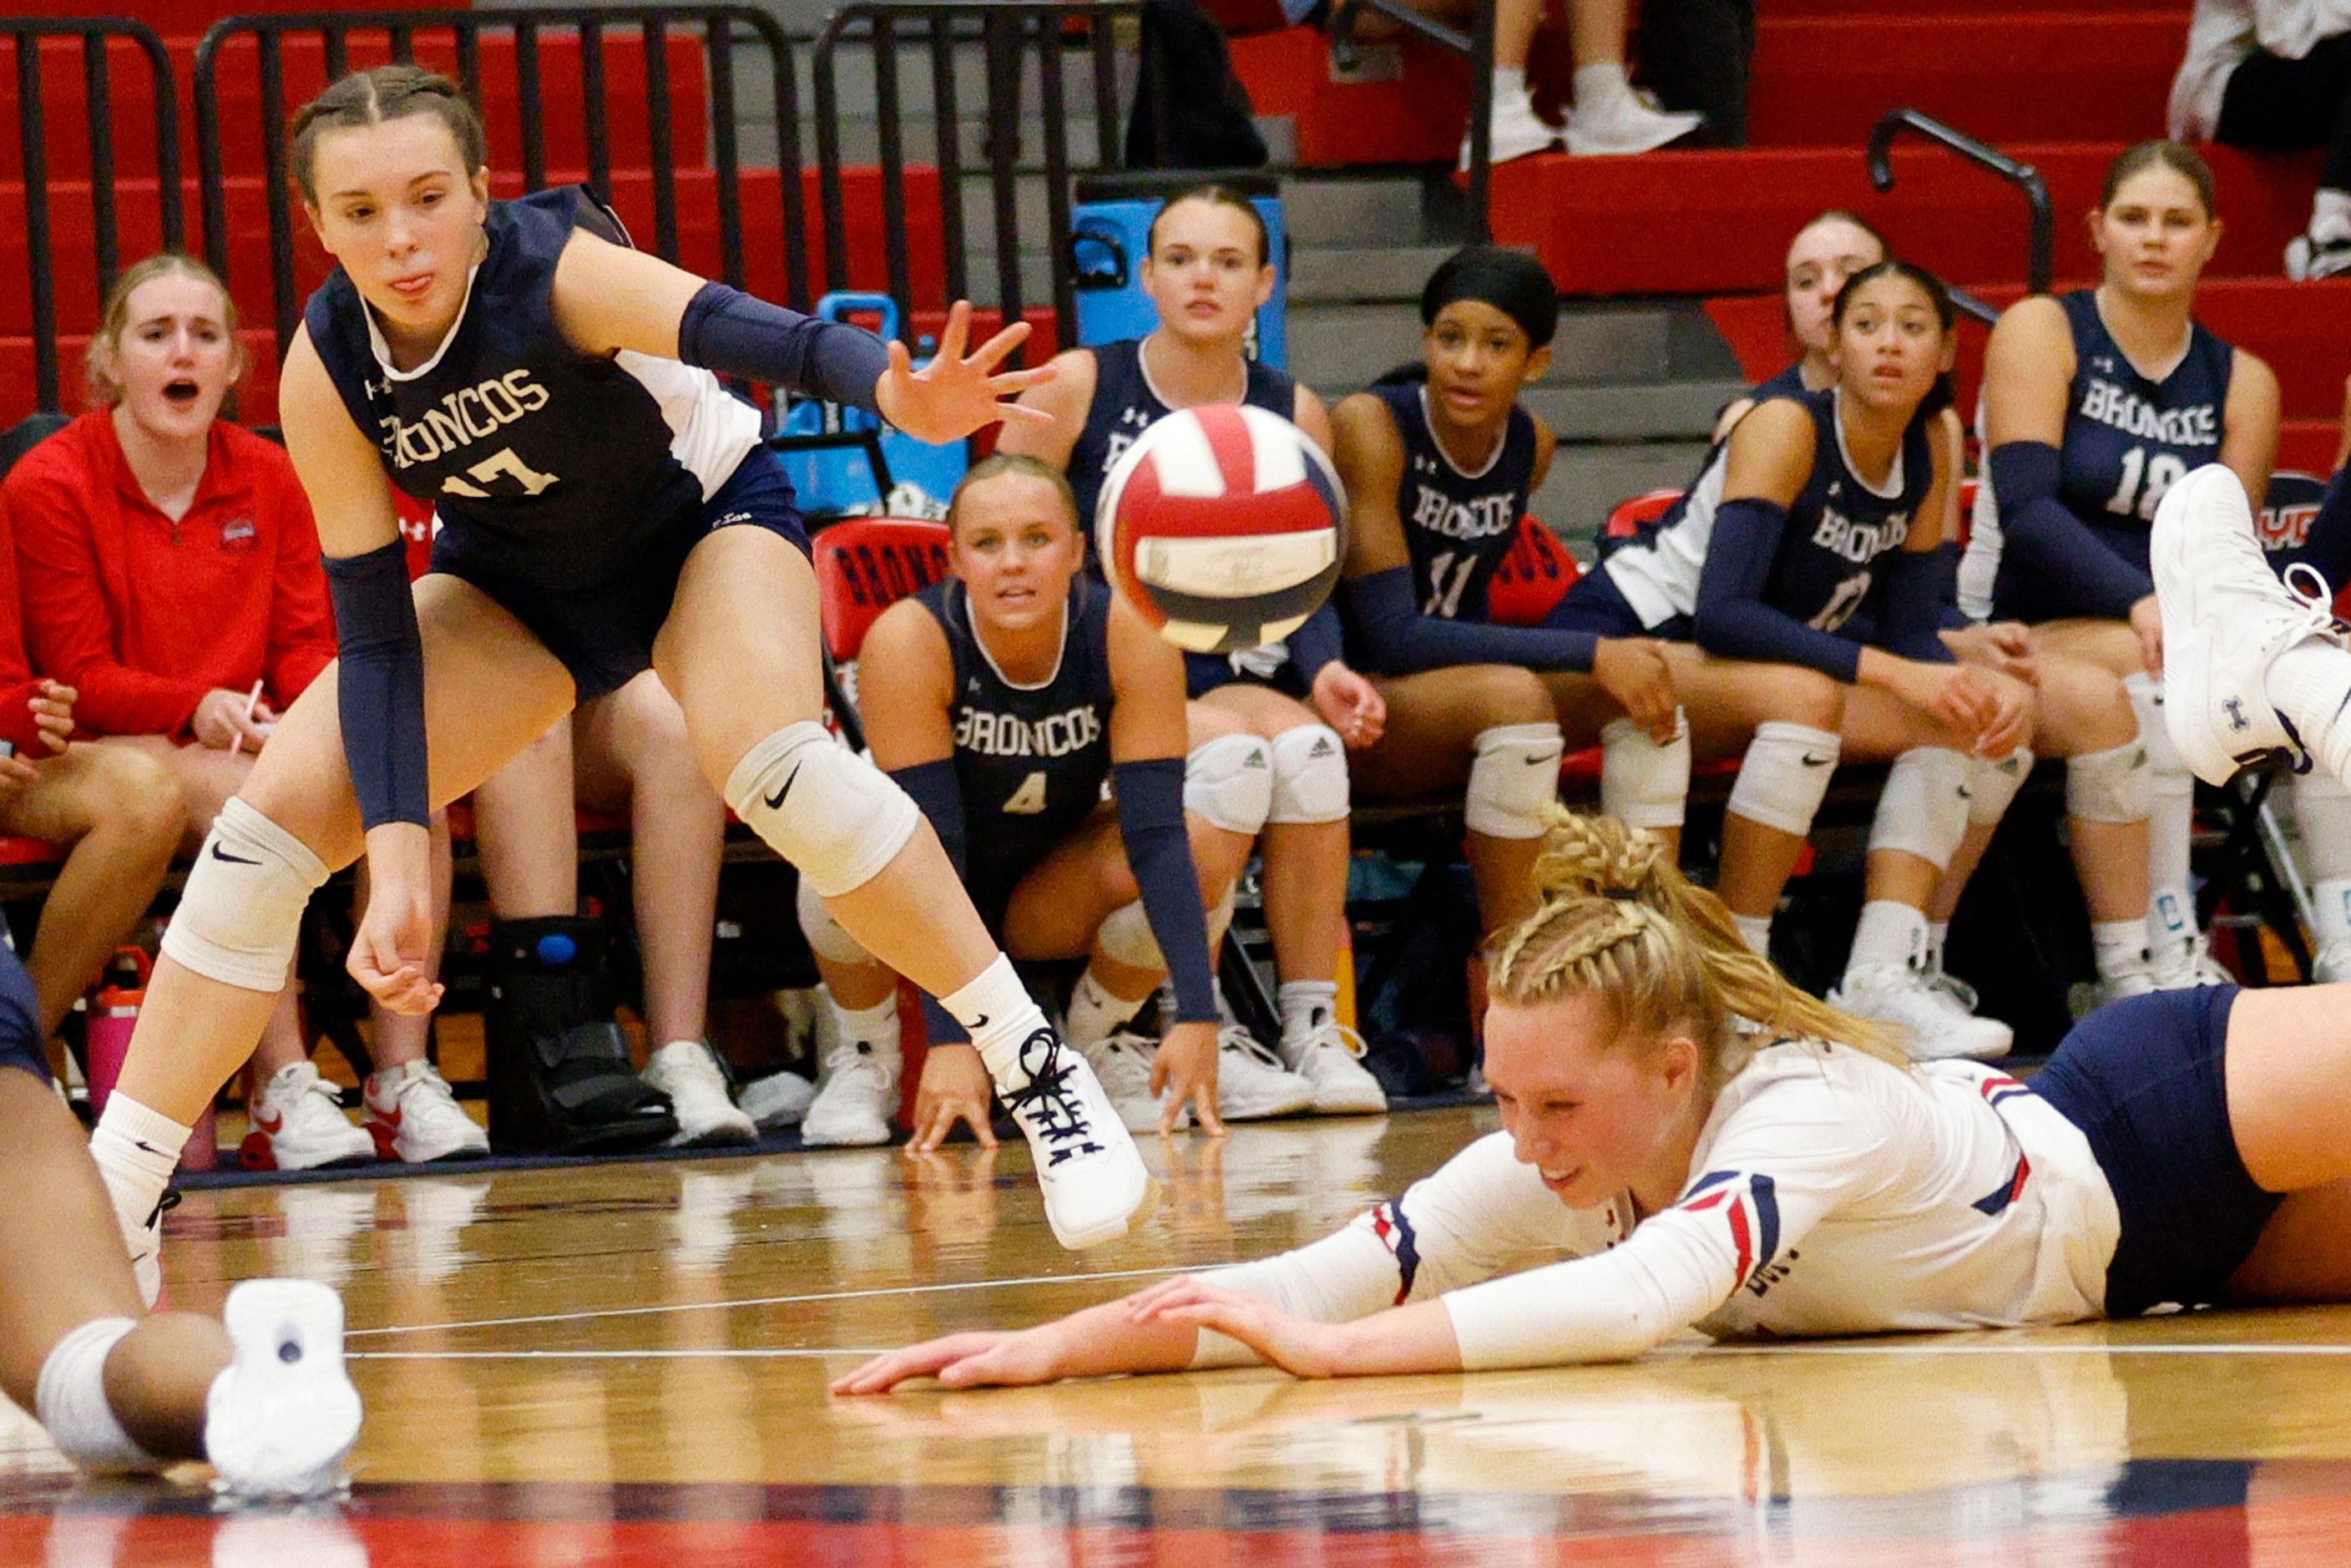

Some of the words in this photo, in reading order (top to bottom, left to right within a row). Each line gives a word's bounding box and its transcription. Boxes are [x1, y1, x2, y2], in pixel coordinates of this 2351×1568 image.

[2081, 378, 2217, 447] BRONCOS
[440, 447, 561, 498] 17
[1003, 771, 1048, 815] 4
